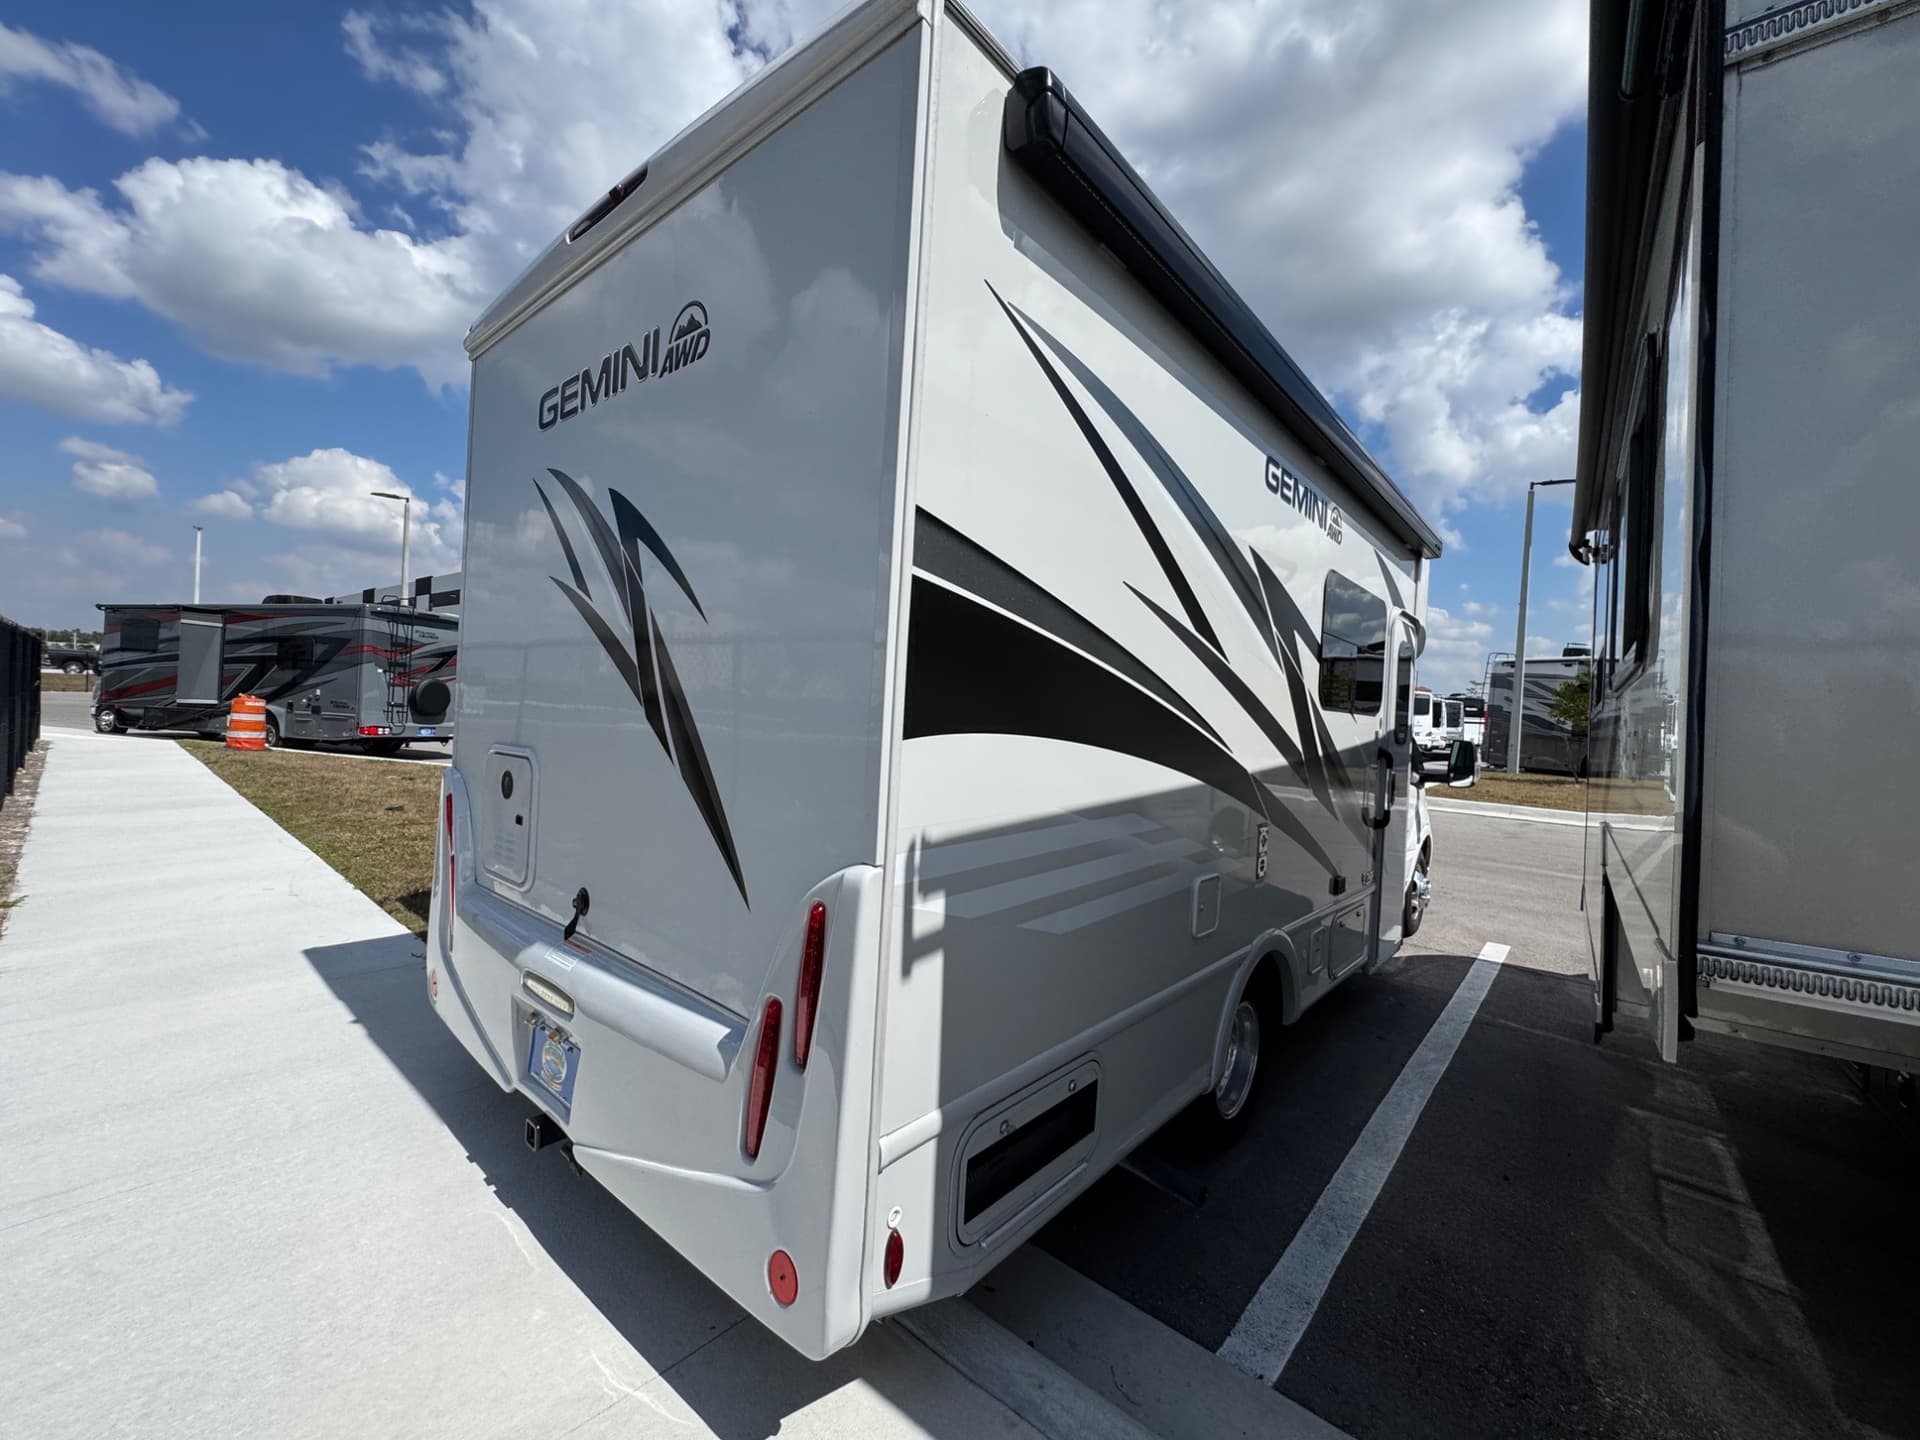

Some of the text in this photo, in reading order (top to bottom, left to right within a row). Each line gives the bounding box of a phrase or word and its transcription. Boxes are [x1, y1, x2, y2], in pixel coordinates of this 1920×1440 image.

[538, 325, 711, 432] GEMINI AWD
[1265, 455, 1343, 546] GEMINI AWD
